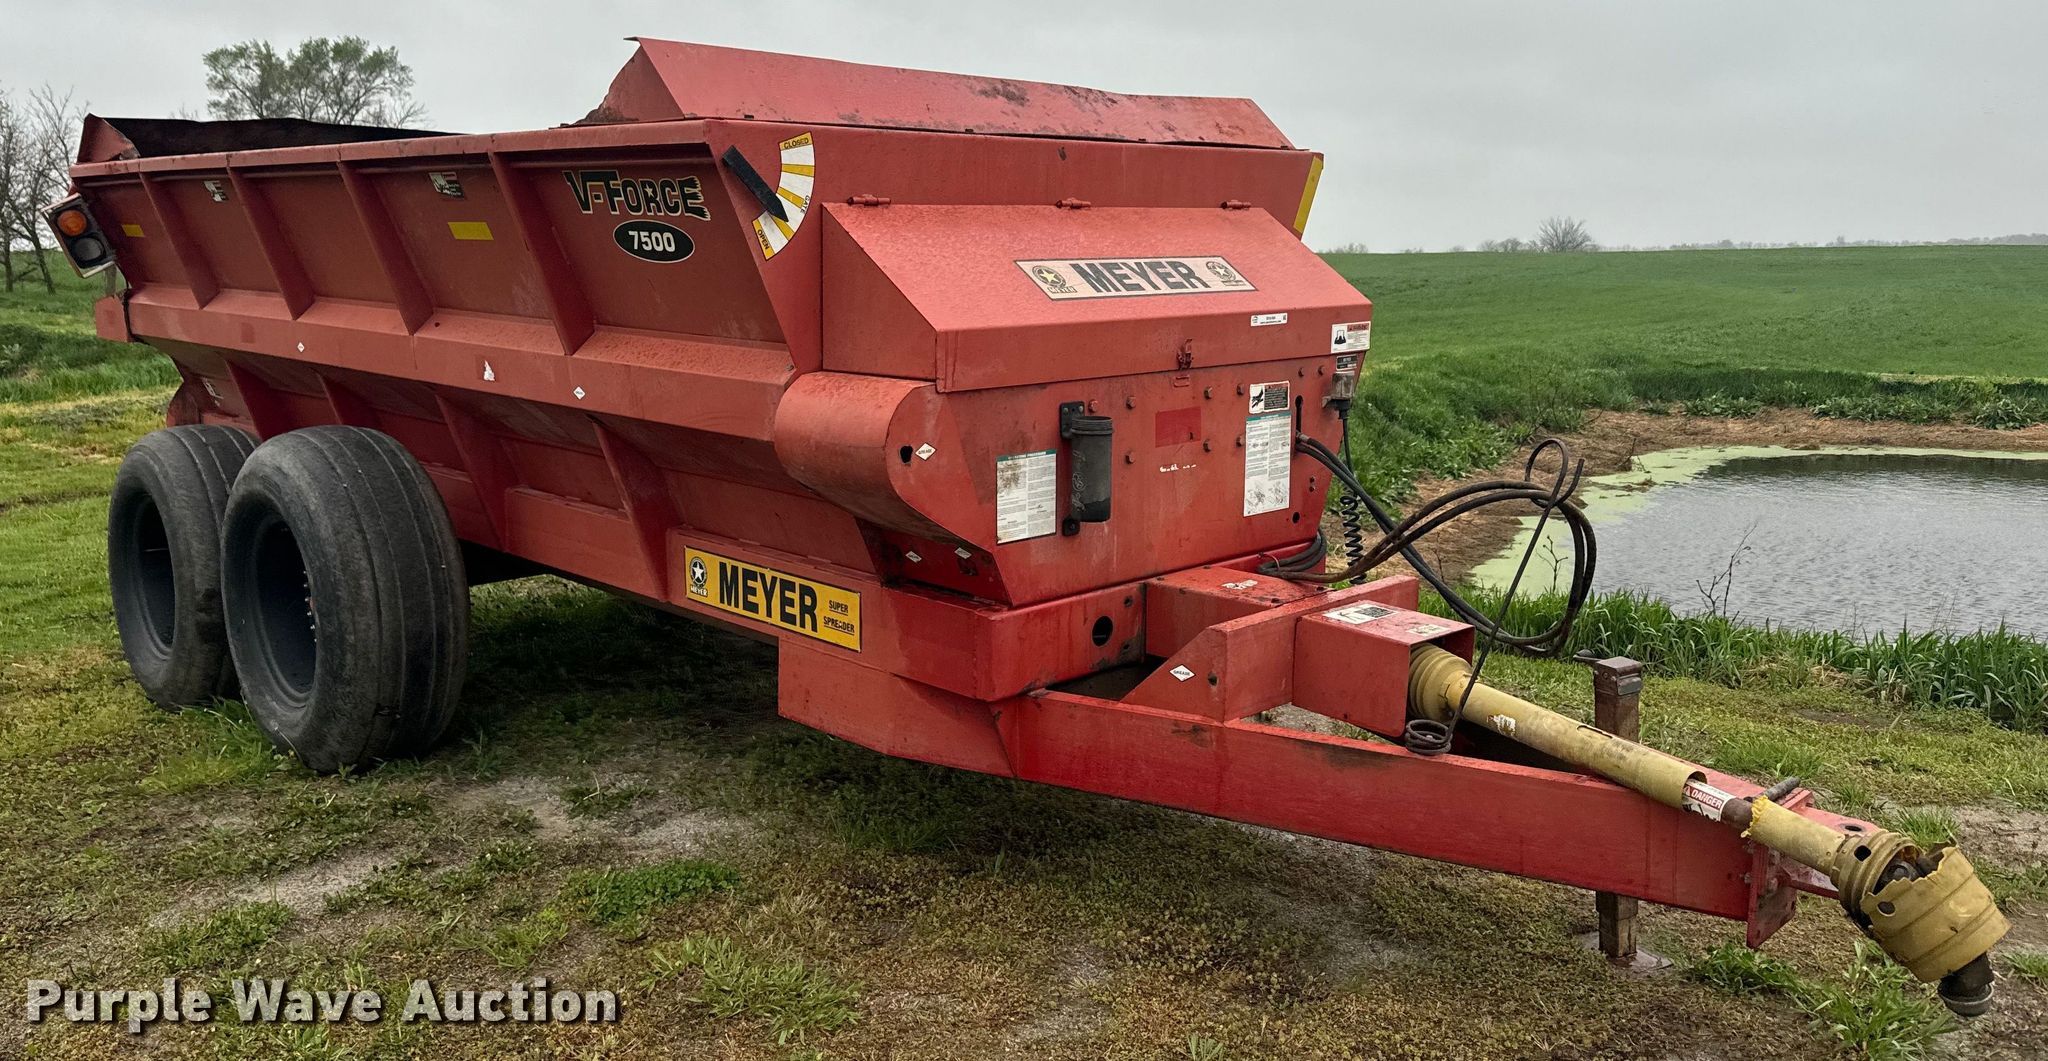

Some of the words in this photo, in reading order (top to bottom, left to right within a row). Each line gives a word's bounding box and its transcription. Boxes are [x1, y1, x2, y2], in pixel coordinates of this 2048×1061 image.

[783, 137, 809, 149] CLOSED
[563, 170, 711, 221] V-FORCE
[800, 195, 810, 214] GATE
[629, 231, 675, 252] 7500
[757, 229, 770, 250] OPEN
[1069, 260, 1211, 293] MEYER
[719, 562, 818, 633] MEYER
[829, 599, 849, 613] SUPER
[823, 616, 855, 633] SPREADER
[1691, 789, 1723, 809] DANGER
